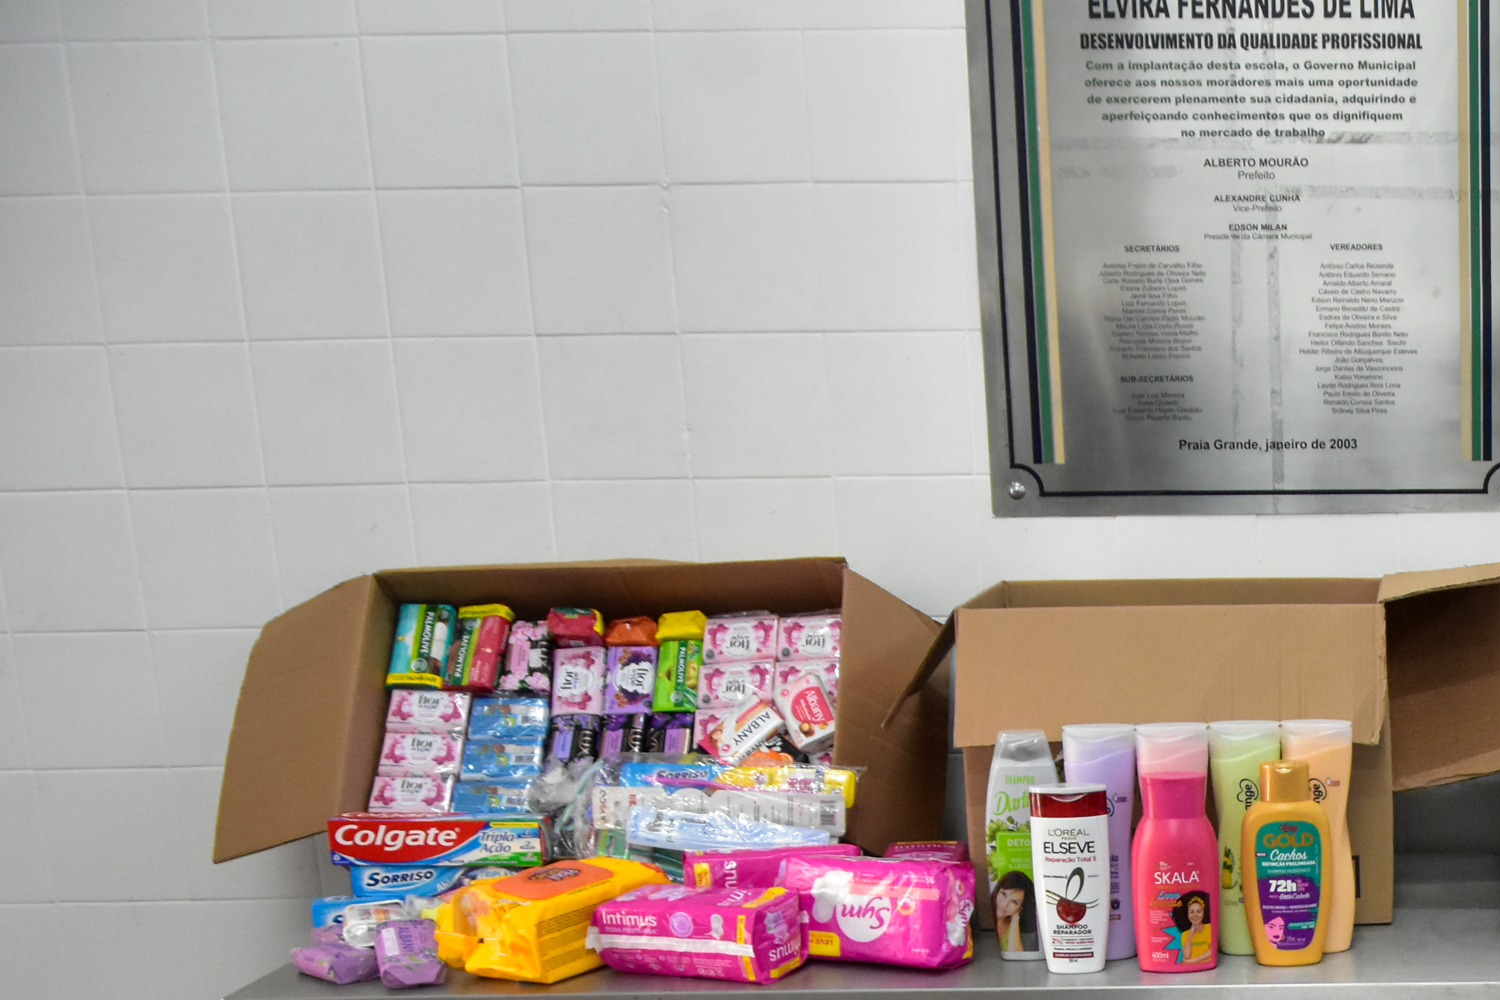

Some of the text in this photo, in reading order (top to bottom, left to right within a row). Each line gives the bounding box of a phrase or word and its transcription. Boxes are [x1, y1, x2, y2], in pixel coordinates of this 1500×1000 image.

[1089, 0, 1415, 19] ELVIRA FERNANDES DE LIMA
[1080, 33, 1422, 50] DESENVOLVIMENTO DA QUALIDADE PROFISSIONAL
[1086, 61, 1112, 70] Com
[1128, 60, 1202, 72] implantação
[1207, 61, 1241, 70] desta
[1245, 61, 1289, 71] escola,
[1304, 61, 1354, 70] Governo
[1358, 60, 1416, 72] Municipal
[1085, 78, 1131, 86] oferece
[1207, 77, 1271, 86] moradores
[1275, 77, 1304, 86] mais
[1338, 77, 1418, 88] oportunidade
[1087, 95, 1101, 104] de
[1106, 96, 1171, 104] exercerem
[1175, 95, 1246, 105] plenamente
[1275, 94, 1338, 105] cidadania,
[1342, 94, 1405, 105] adquirindo
[1102, 111, 1188, 122] aperfeiçoando
[1192, 111, 1285, 120] conhecimentos
[1289, 113, 1311, 122] que
[1333, 111, 1403, 122] dignifiquem
[1181, 128, 1325, 137] no mercado de trabalho
[1204, 156, 1308, 167] ALBERTO MOURÃO
[1238, 171, 1275, 180] Prefeito
[1179, 438, 1357, 452] Praia Grande, janeiro de 2003
[420, 611, 435, 653] PALMOLIVE
[454, 635, 470, 677] PALMOLIVE
[804, 690, 825, 722] Albany
[734, 711, 771, 746] ALBANY
[335, 825, 457, 851] Colgate
[479, 831, 515, 843] Tripla
[1263, 833, 1314, 848] GOLD
[481, 843, 512, 855] Ação
[1044, 841, 1095, 854] ELSEVE
[1270, 848, 1308, 861] Cachos
[366, 870, 434, 887] SORRISO
[1154, 871, 1199, 884] SKALA
[1269, 880, 1297, 892] 72h
[602, 911, 657, 927] Intimus
[840, 896, 890, 930] Sym
